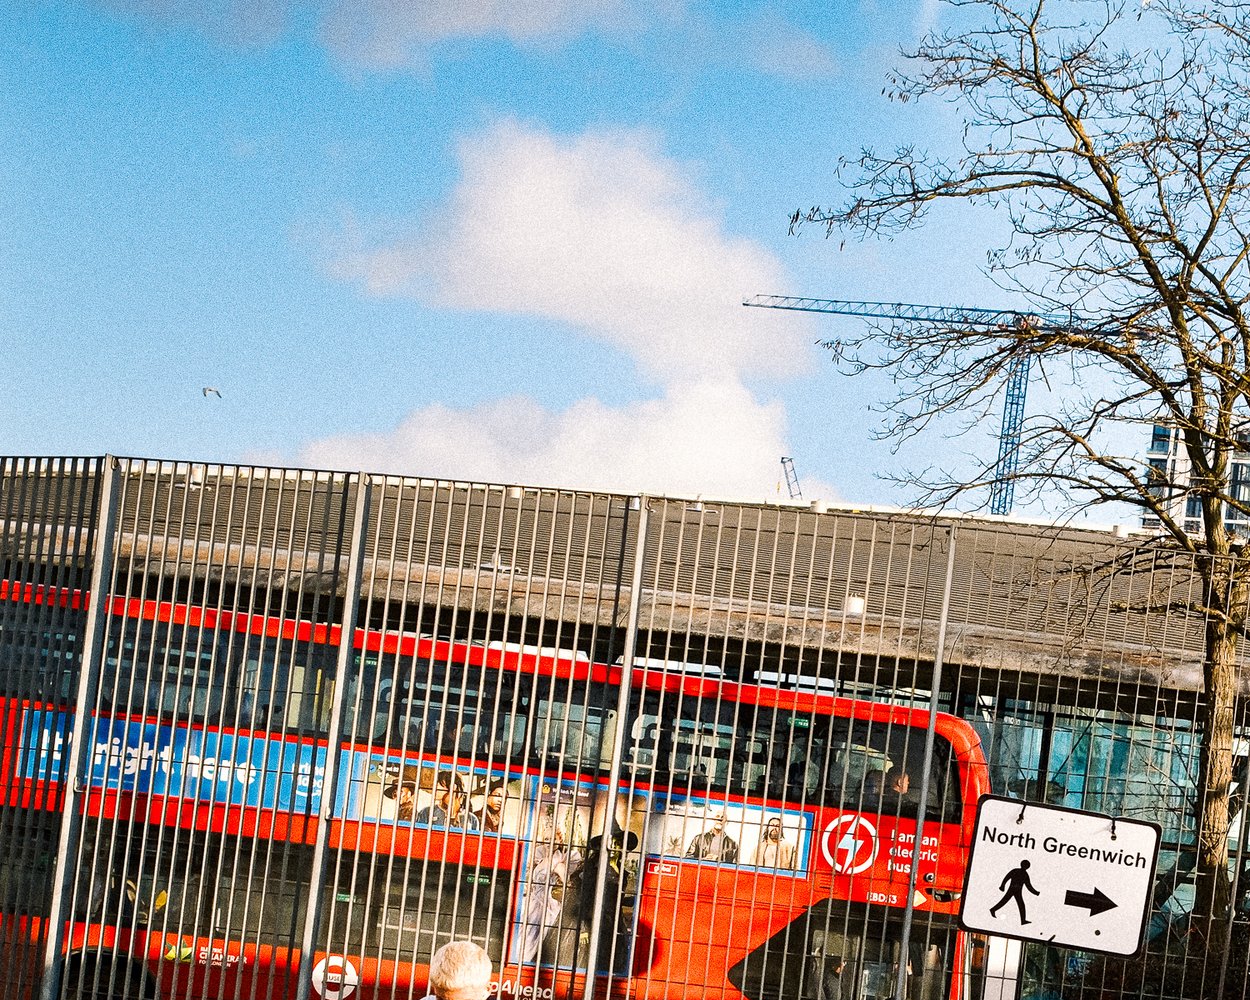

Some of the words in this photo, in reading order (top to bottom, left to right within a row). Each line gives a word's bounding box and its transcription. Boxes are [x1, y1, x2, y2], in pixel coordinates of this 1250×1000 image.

[41, 728, 76, 760] It'
[94, 737, 175, 775] right
[180, 747, 256, 785] here
[898, 832, 918, 843] am
[921, 837, 938, 847] an
[982, 826, 1036, 850] North
[1042, 836, 1148, 868] Greenwich
[889, 847, 938, 862] elecric
[866, 891, 898, 904] EBD3
[482, 978, 555, 1000] oAhead
